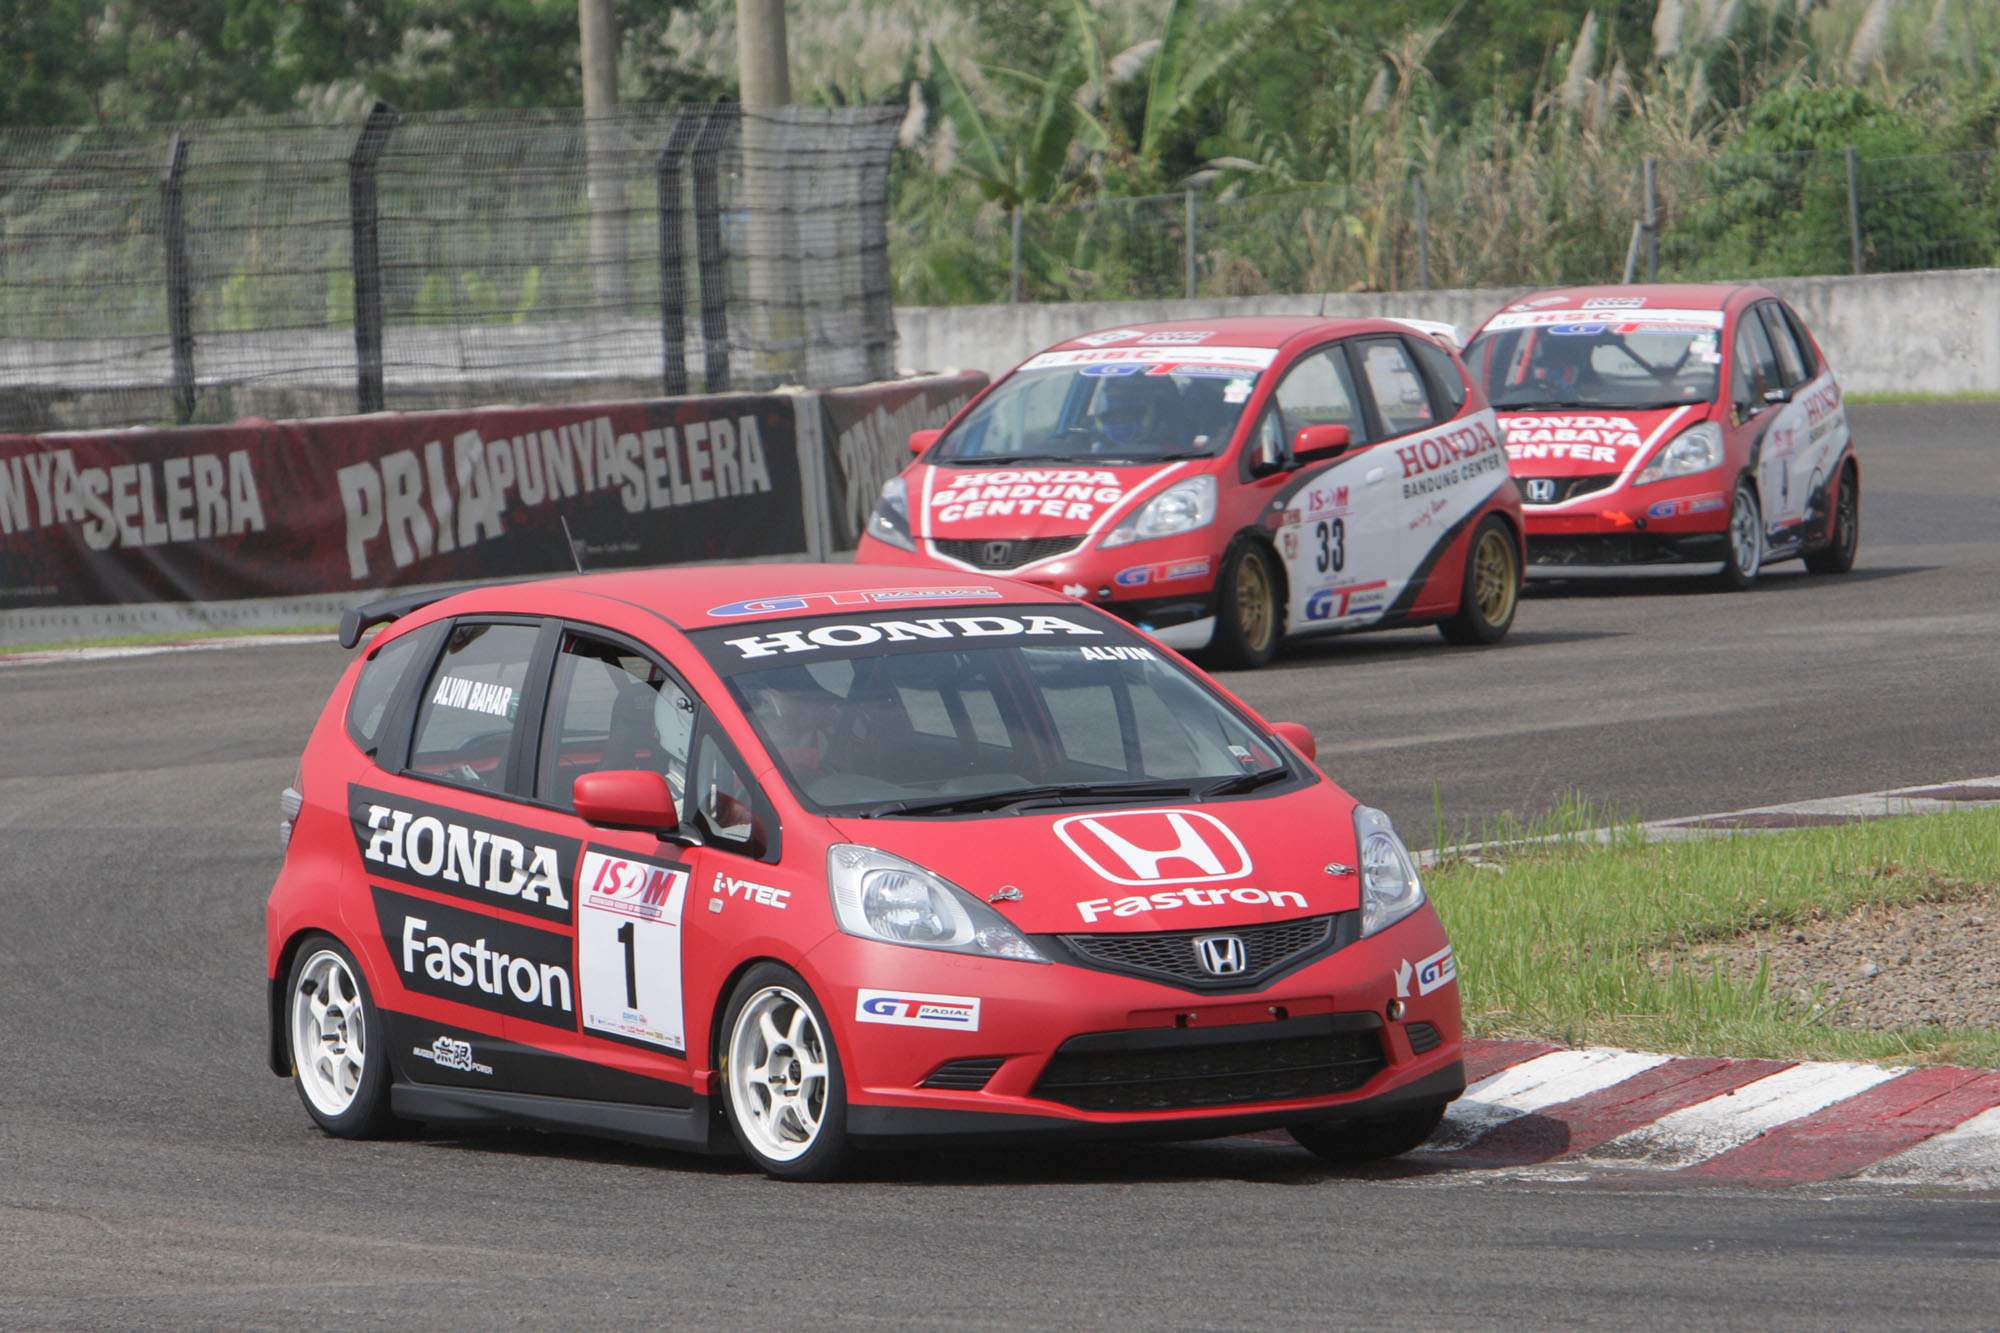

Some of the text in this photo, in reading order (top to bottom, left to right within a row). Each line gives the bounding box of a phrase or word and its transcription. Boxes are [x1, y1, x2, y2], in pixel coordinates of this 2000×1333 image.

[1396, 421, 1497, 479] HONDA
[337, 415, 772, 580] PRIA PUNYA SELERA
[931, 484, 1122, 506] BANDUNG
[949, 470, 1121, 488] HONDA
[1403, 454, 1500, 499] BANDUNG CENTER
[78, 450, 266, 551] SELERA
[938, 499, 1094, 523] CENTER
[1316, 517, 1345, 573] 33
[1306, 582, 1364, 619] GT
[723, 615, 1104, 659] HONDA
[1079, 645, 1157, 662] ALVIN
[432, 676, 512, 717] ALVIN BAHAR
[365, 804, 569, 910] HONDA
[1076, 888, 1308, 923] Fastron
[402, 915, 572, 1012] Fastron
[617, 921, 638, 1010] 1
[1421, 956, 1449, 985] GT
[863, 997, 971, 1018] GT RADIAL
